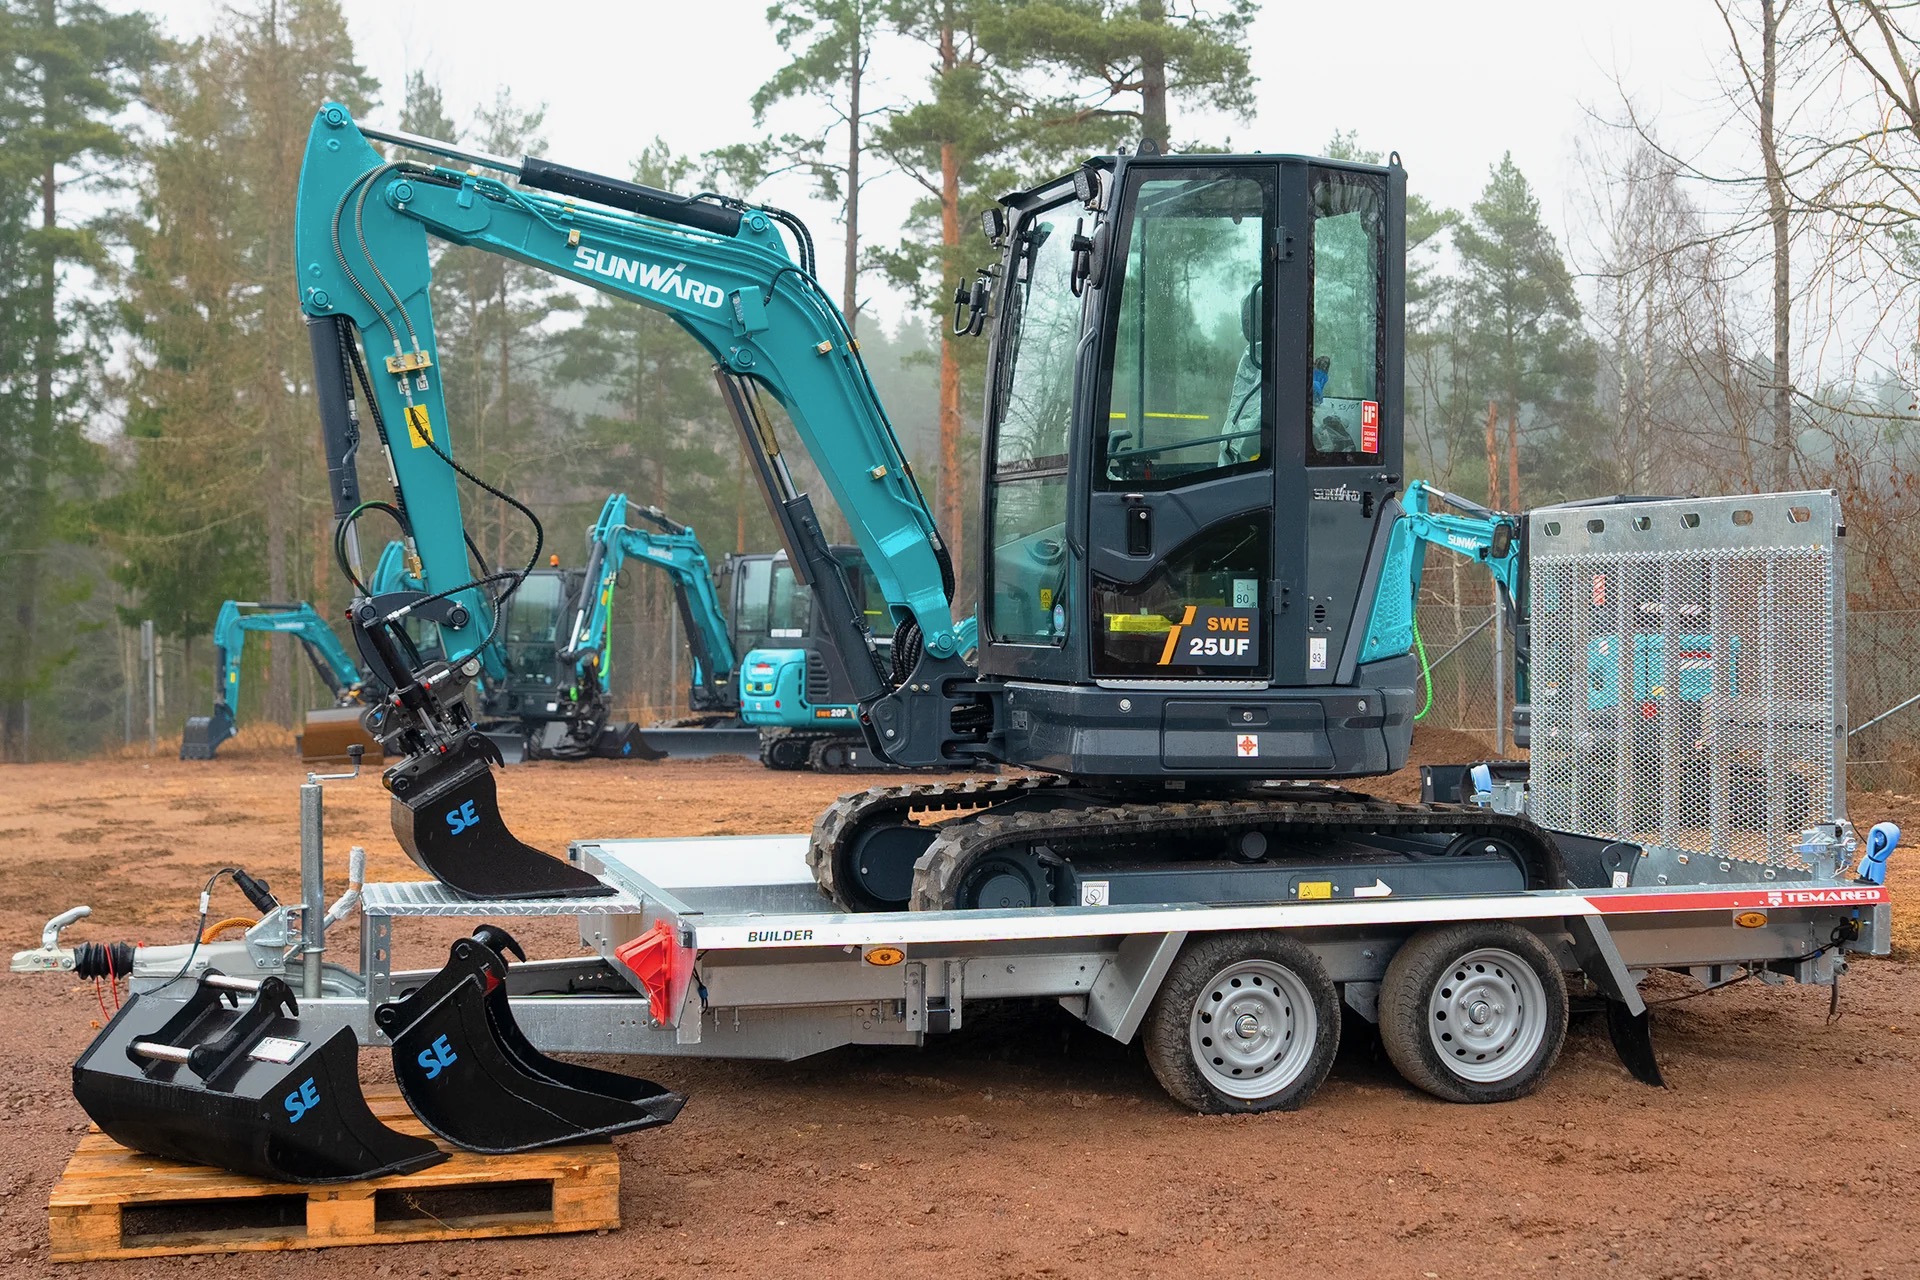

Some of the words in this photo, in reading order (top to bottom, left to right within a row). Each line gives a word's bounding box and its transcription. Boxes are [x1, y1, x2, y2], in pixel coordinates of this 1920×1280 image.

[573, 246, 725, 309] SUNWARD
[1236, 594, 1249, 604] 80
[1207, 617, 1249, 632] SWE
[1189, 638, 1250, 656] 25UF
[445, 799, 480, 836] SE
[1784, 890, 1880, 903] TEMARED
[748, 929, 813, 943] BUILDER
[417, 1033, 458, 1080] SE
[284, 1076, 321, 1124] SE
